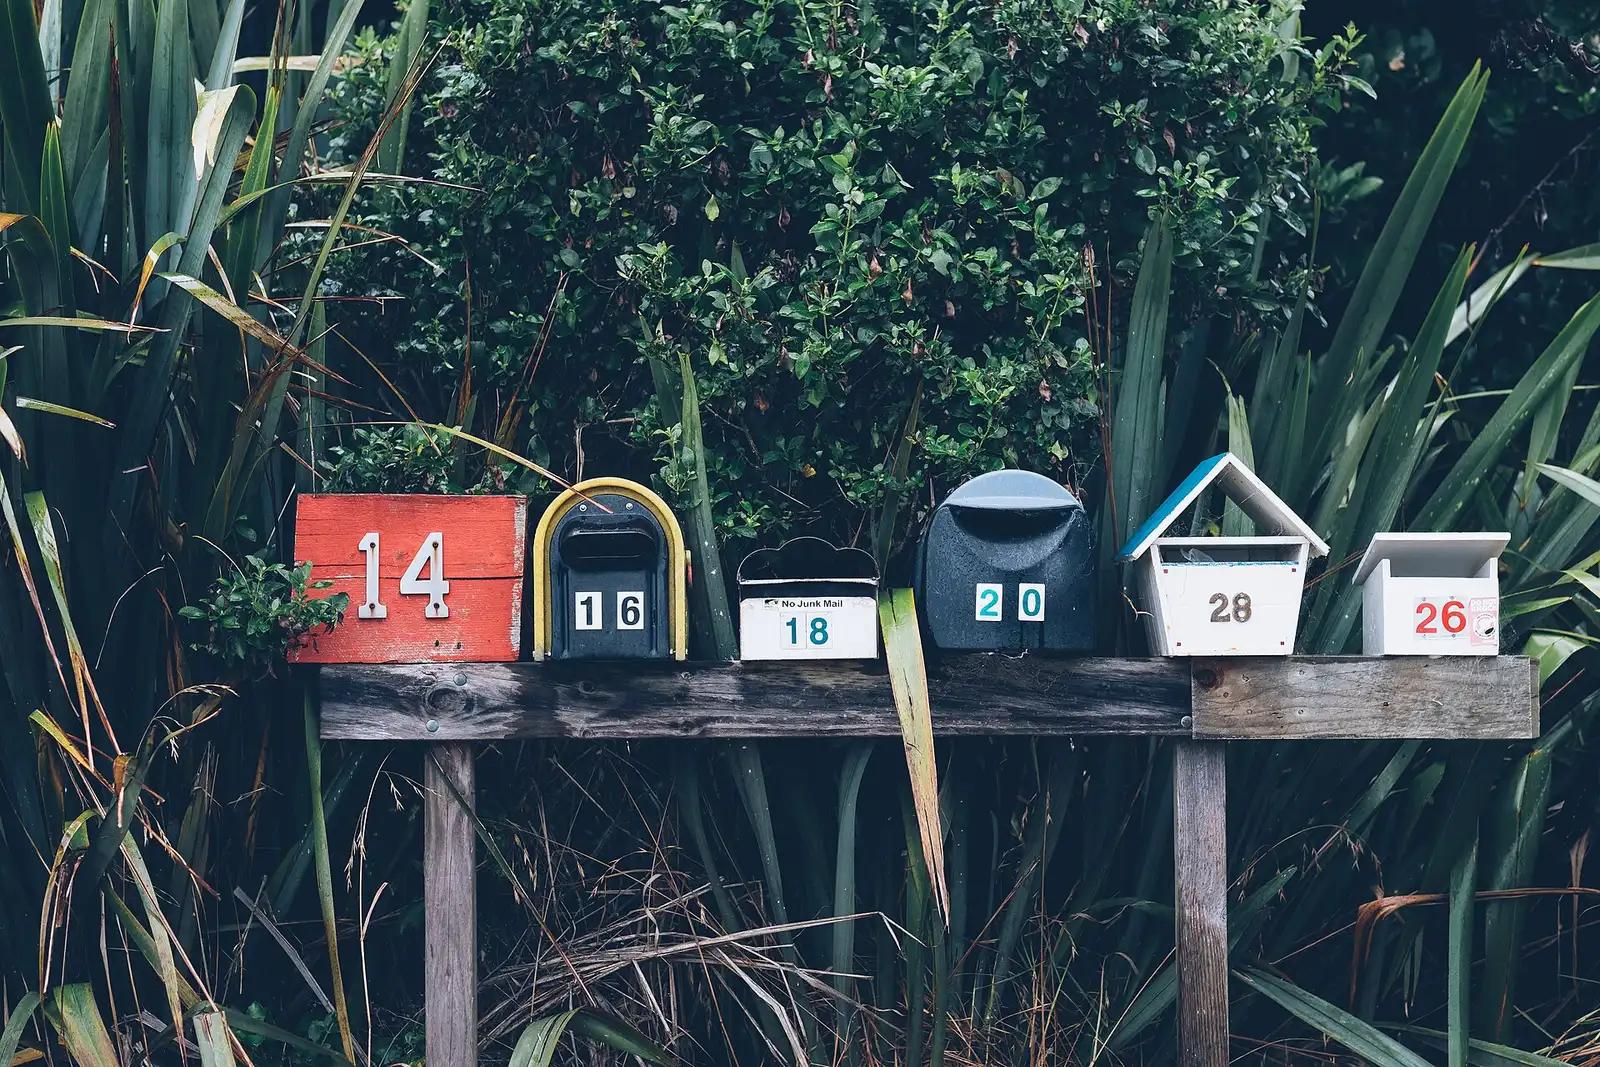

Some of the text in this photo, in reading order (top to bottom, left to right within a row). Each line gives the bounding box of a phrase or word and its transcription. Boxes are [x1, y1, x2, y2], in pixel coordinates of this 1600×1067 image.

[357, 531, 450, 619] 14
[579, 595, 642, 627] 16
[781, 600, 843, 608] No Junk Mail
[979, 587, 1041, 617] 20
[1209, 592, 1252, 623] 28
[1415, 600, 1467, 634] 26
[786, 617, 829, 645] 18
